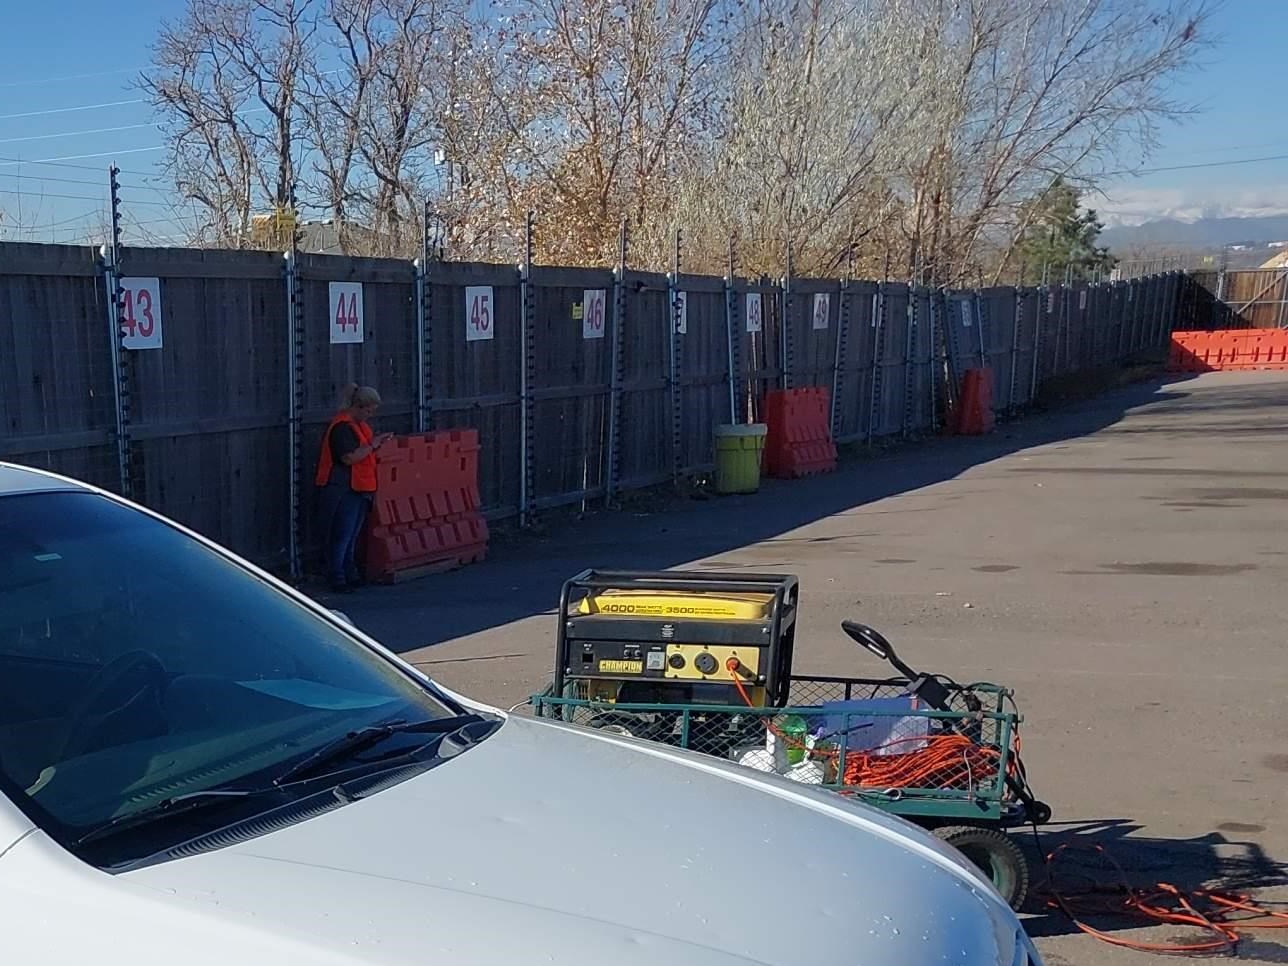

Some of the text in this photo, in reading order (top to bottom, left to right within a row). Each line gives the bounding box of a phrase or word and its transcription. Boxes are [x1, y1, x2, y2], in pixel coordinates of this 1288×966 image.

[121, 289, 154, 338] 43
[336, 293, 359, 332] 44
[470, 294, 490, 331] 45
[587, 298, 602, 331] 46
[749, 299, 759, 325] 48
[815, 298, 827, 324] 49
[601, 604, 635, 613] 4000
[666, 606, 695, 614] 3500
[600, 661, 643, 672] CHAMPION
